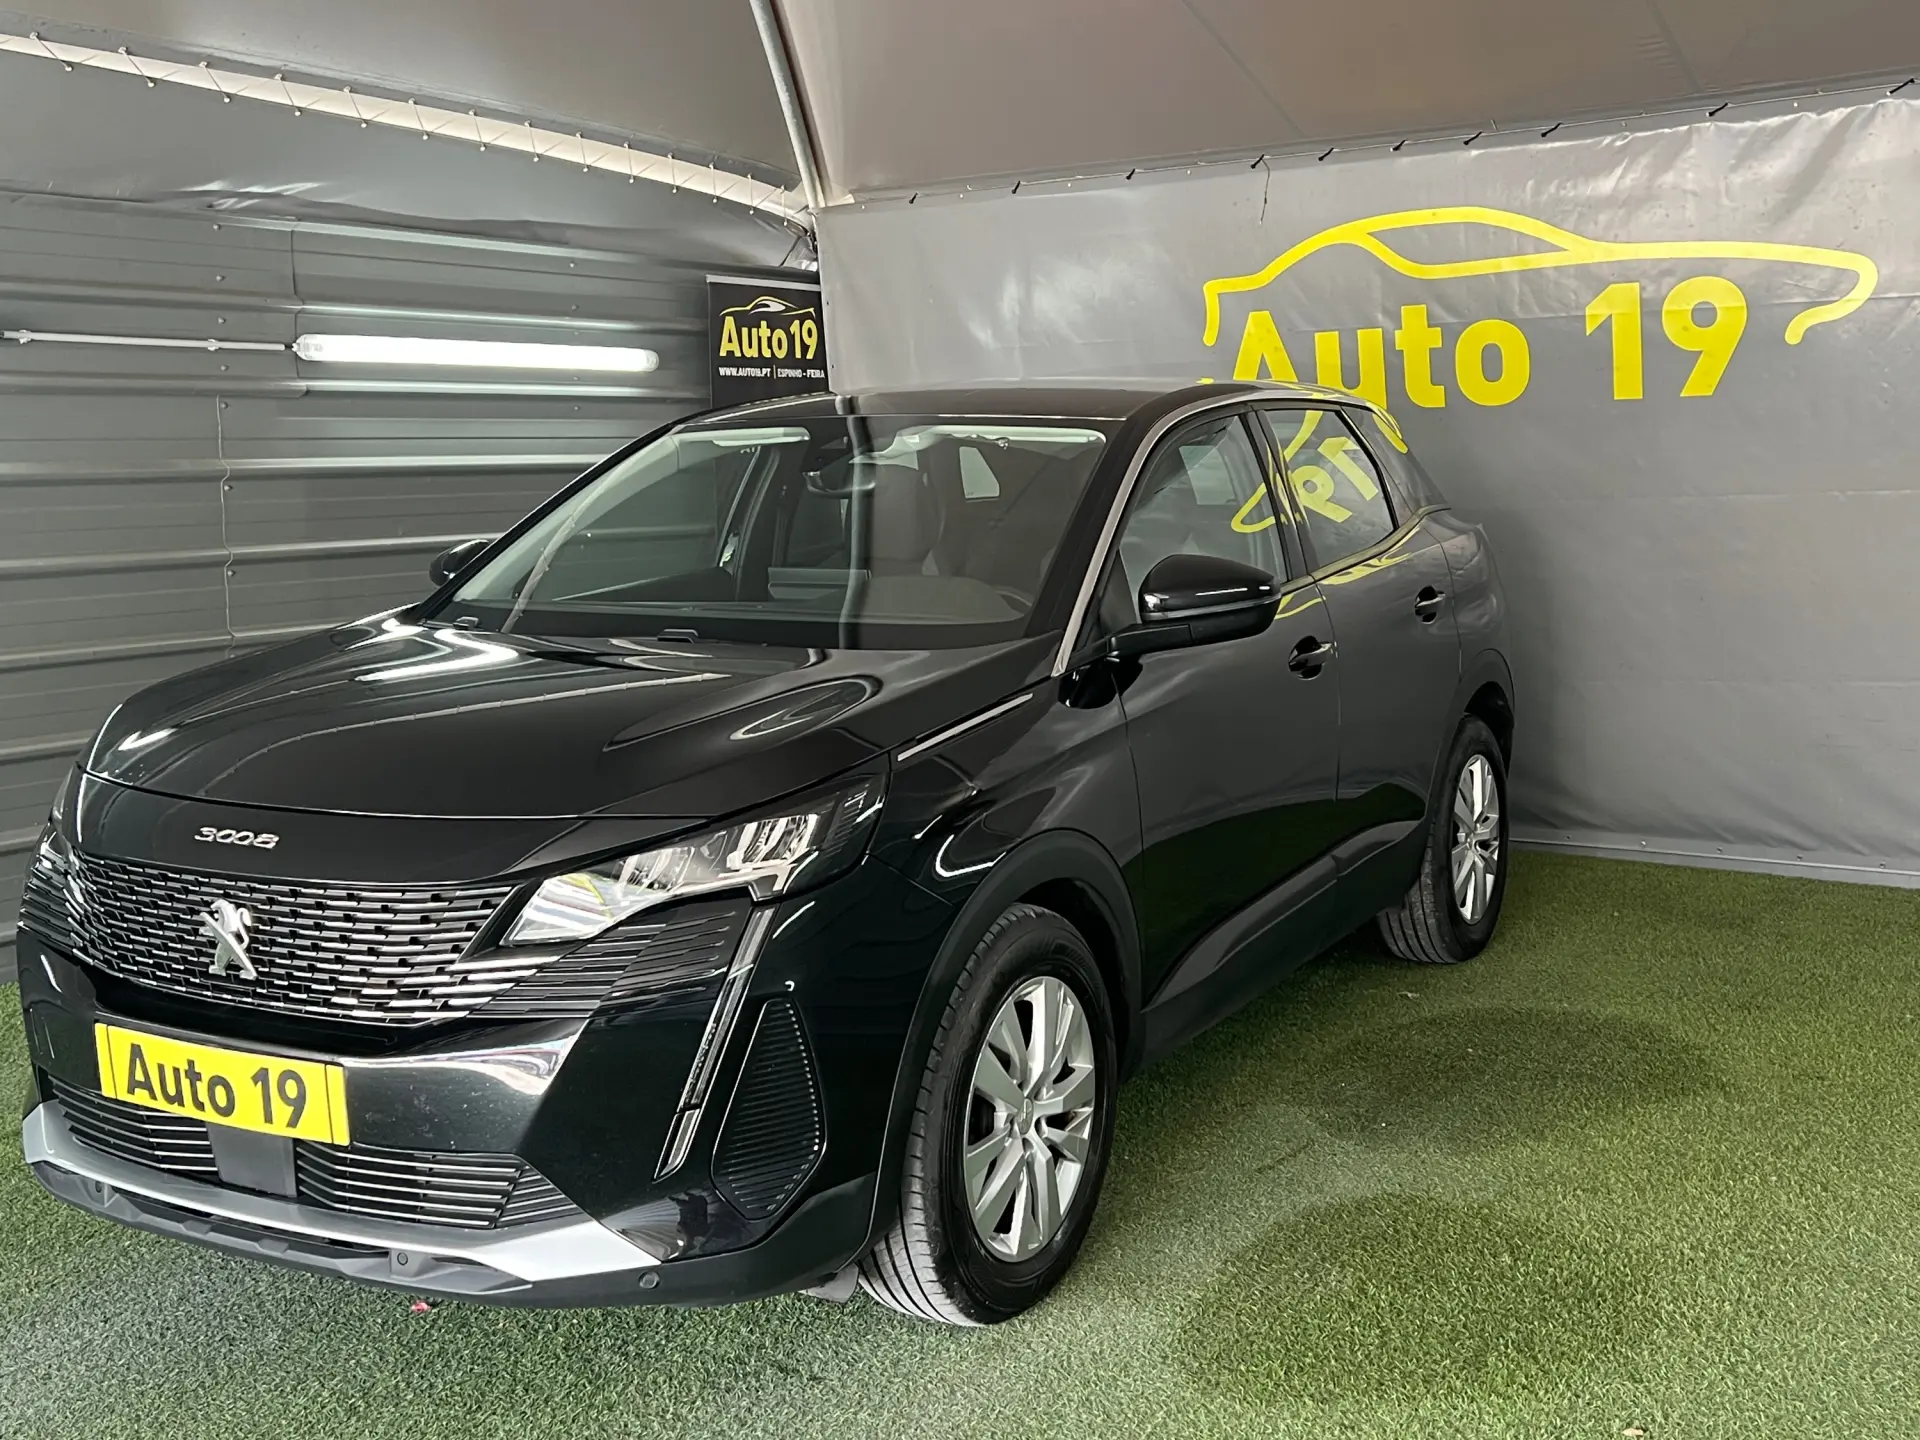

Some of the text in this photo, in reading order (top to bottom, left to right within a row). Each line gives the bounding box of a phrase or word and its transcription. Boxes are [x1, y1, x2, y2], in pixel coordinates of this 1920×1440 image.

[719, 316, 818, 360] Auto 19
[1232, 276, 1748, 408] Auto 19
[194, 827, 280, 849] 3008
[127, 1043, 307, 1129] Auto 19
